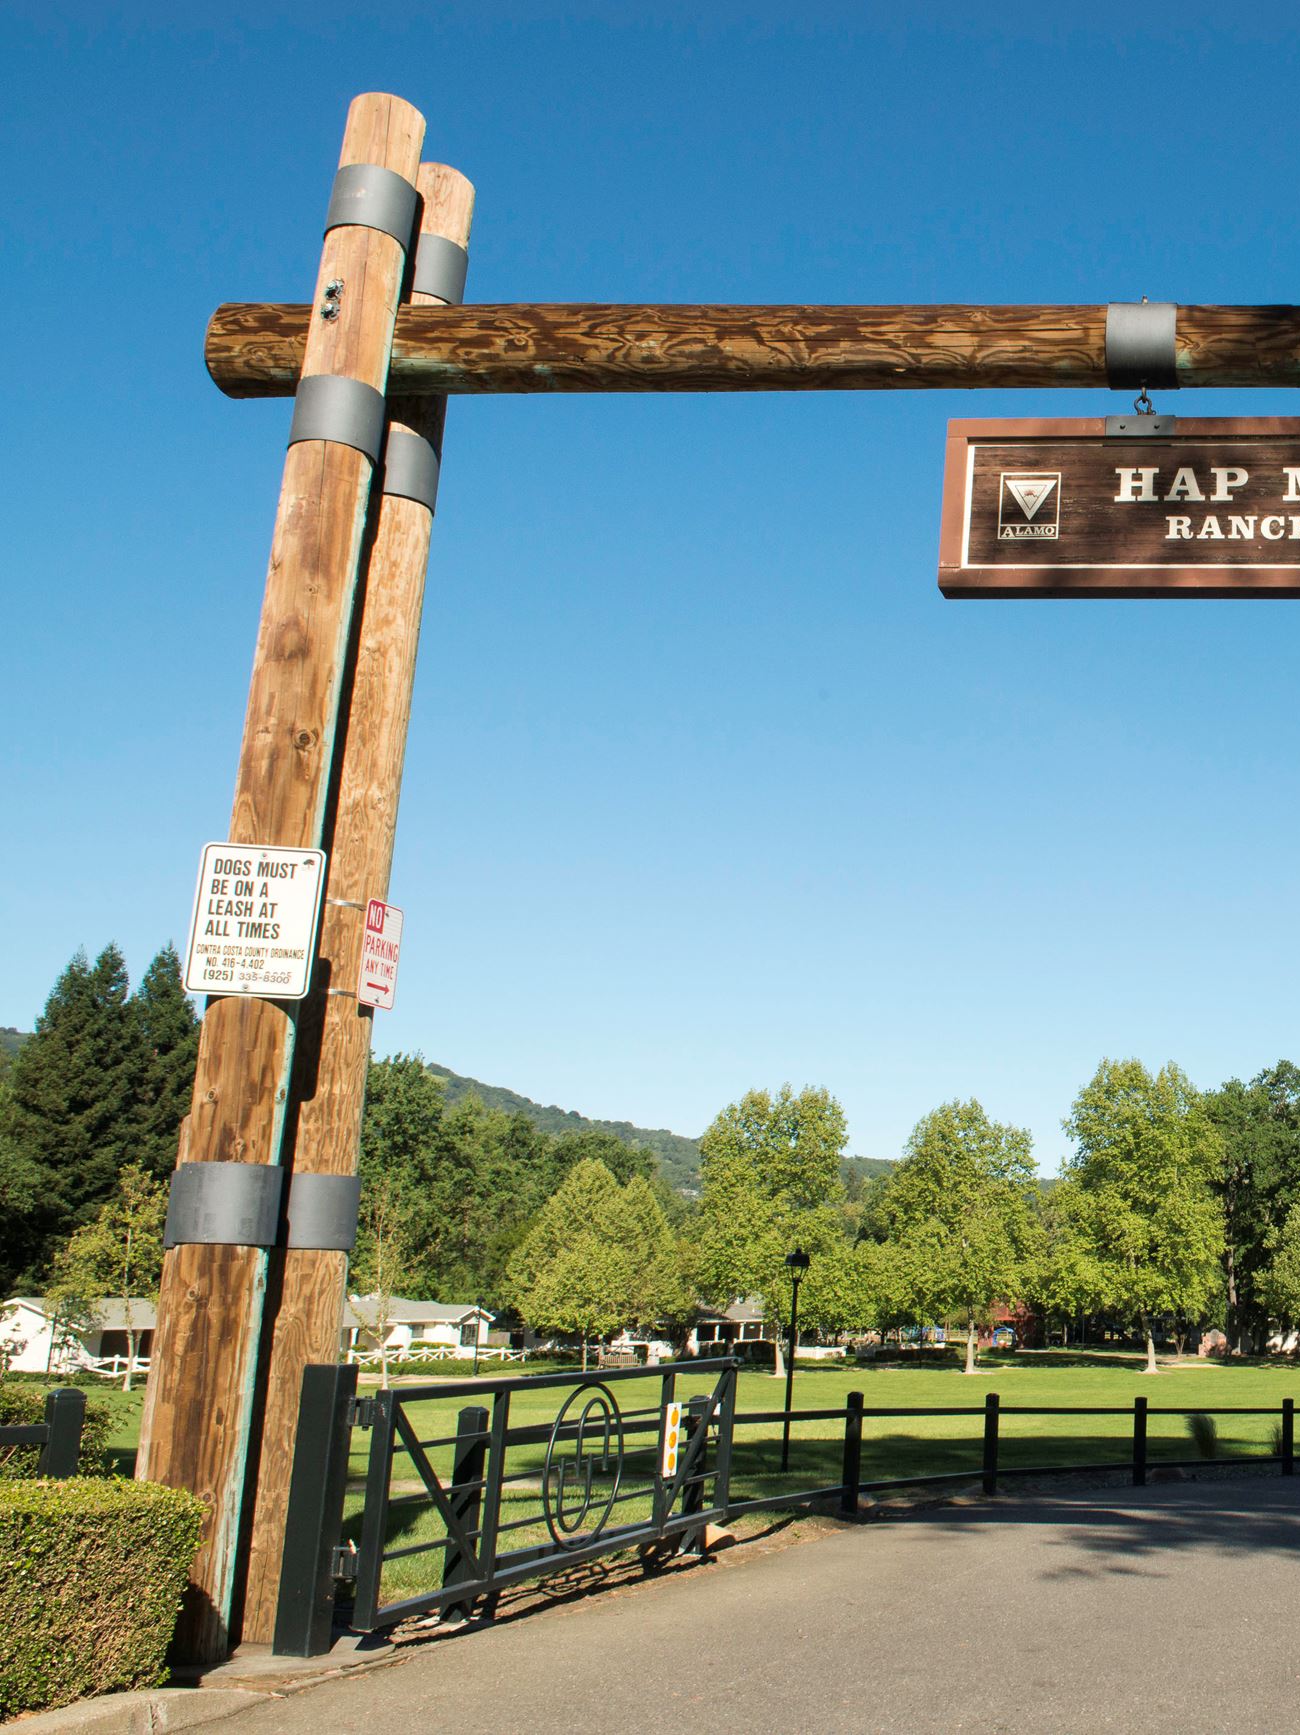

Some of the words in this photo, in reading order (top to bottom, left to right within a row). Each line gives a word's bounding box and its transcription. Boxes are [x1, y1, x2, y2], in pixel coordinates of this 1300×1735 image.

[1114, 467, 1249, 502] HAP
[1001, 526, 1055, 538] ALAMO
[214, 858, 252, 876] DOGS
[257, 861, 298, 879] MUST
[211, 878, 229, 895] BE
[234, 880, 254, 897] ON
[259, 882, 269, 898] A
[208, 899, 254, 917] LEASH
[258, 902, 278, 919] AT
[369, 904, 383, 929] NO
[204, 919, 230, 937] ALL
[237, 921, 280, 940] TIMES
[196, 943, 221, 955] CONTRA
[223, 945, 242, 957] COSTA
[244, 946, 269, 958] COUNTY
[270, 948, 305, 960] ORDINANCE
[365, 935, 398, 963] PARKING
[206, 957, 219, 967] NO.
[365, 958, 379, 975] ANY
[381, 962, 394, 980] TIME
[203, 969, 234, 982] (925)
